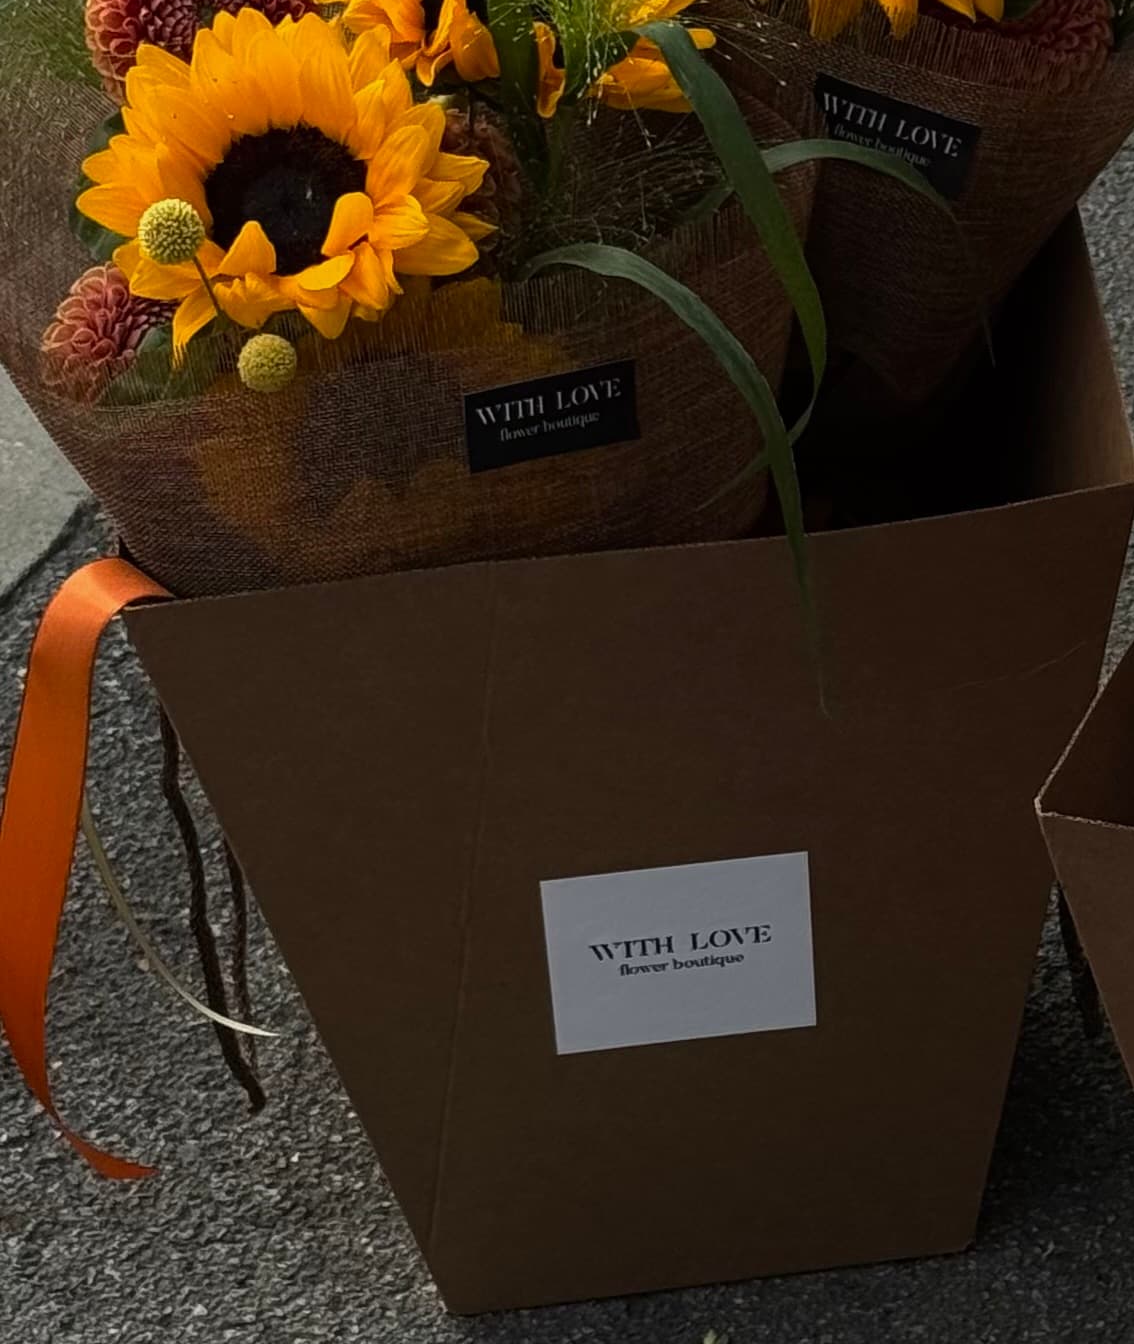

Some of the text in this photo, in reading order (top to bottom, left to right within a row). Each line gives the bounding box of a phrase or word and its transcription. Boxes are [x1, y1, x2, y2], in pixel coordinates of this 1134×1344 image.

[824, 92, 962, 157] WITH LOVE
[476, 378, 622, 425] WITH LOVE
[500, 413, 600, 442] flower boutique
[588, 924, 772, 962] WITH LOVE
[618, 953, 745, 976] flower boutique
